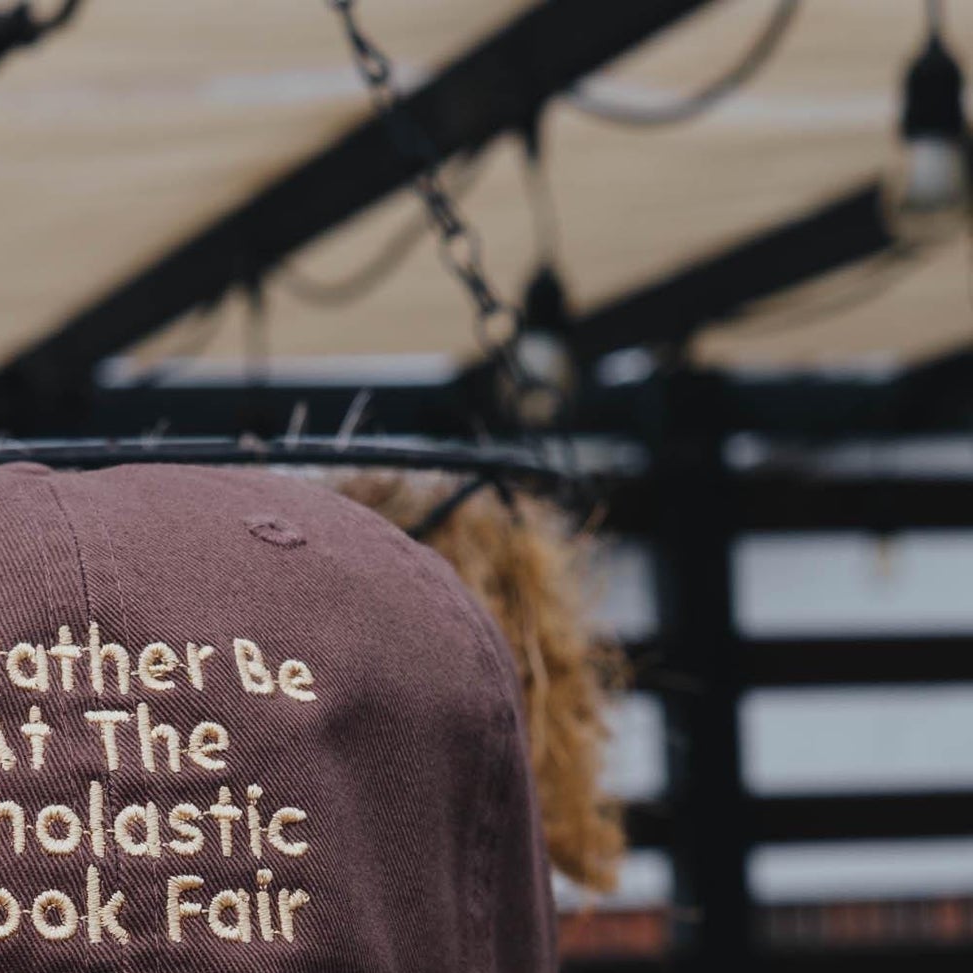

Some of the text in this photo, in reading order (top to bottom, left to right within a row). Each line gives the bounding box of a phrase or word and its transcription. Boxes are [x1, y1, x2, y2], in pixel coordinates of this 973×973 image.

[233, 638, 318, 701] Be
[84, 702, 229, 773] The
[167, 868, 311, 943] Fair
